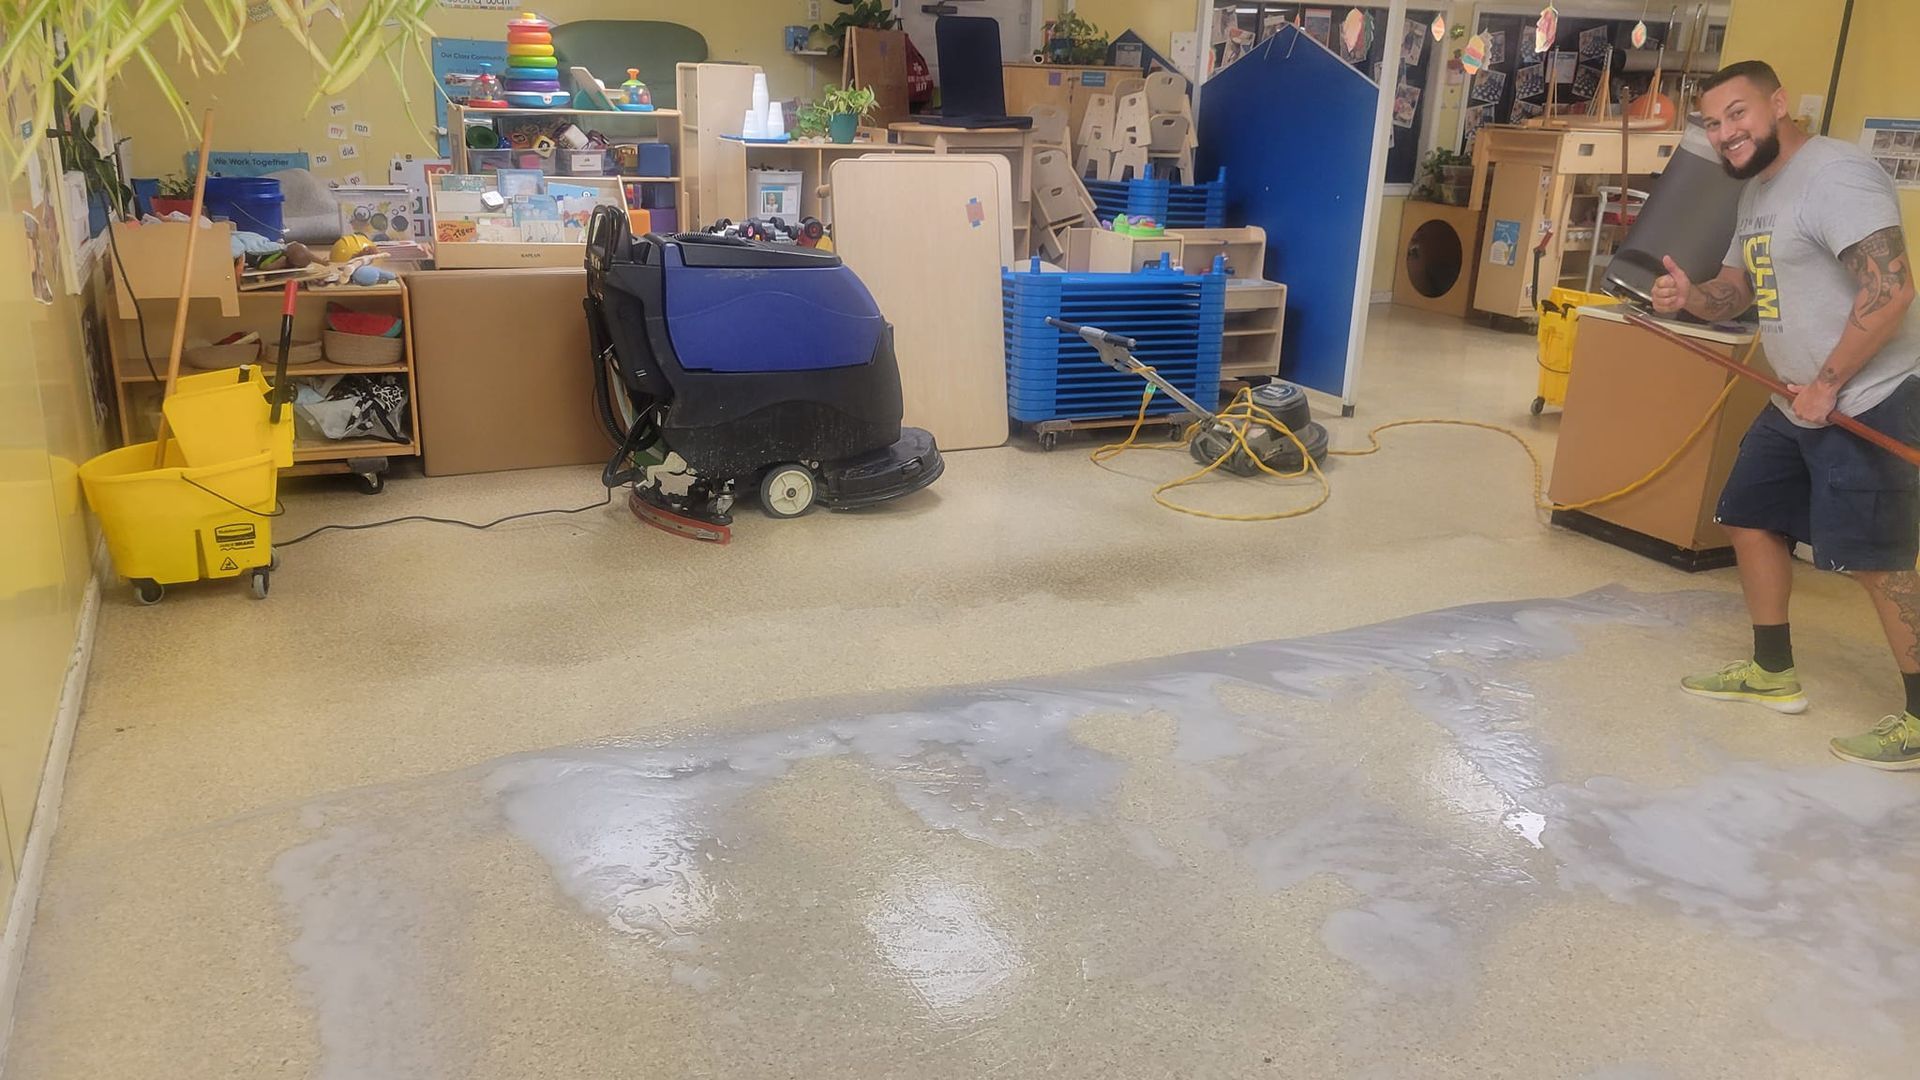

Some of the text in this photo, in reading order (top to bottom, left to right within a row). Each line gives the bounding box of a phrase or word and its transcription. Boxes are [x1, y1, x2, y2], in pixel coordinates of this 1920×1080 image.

[331, 104, 345, 114] yes
[354, 124, 368, 132] ran
[342, 147, 354, 156] did
[214, 157, 289, 167] We Work Together
